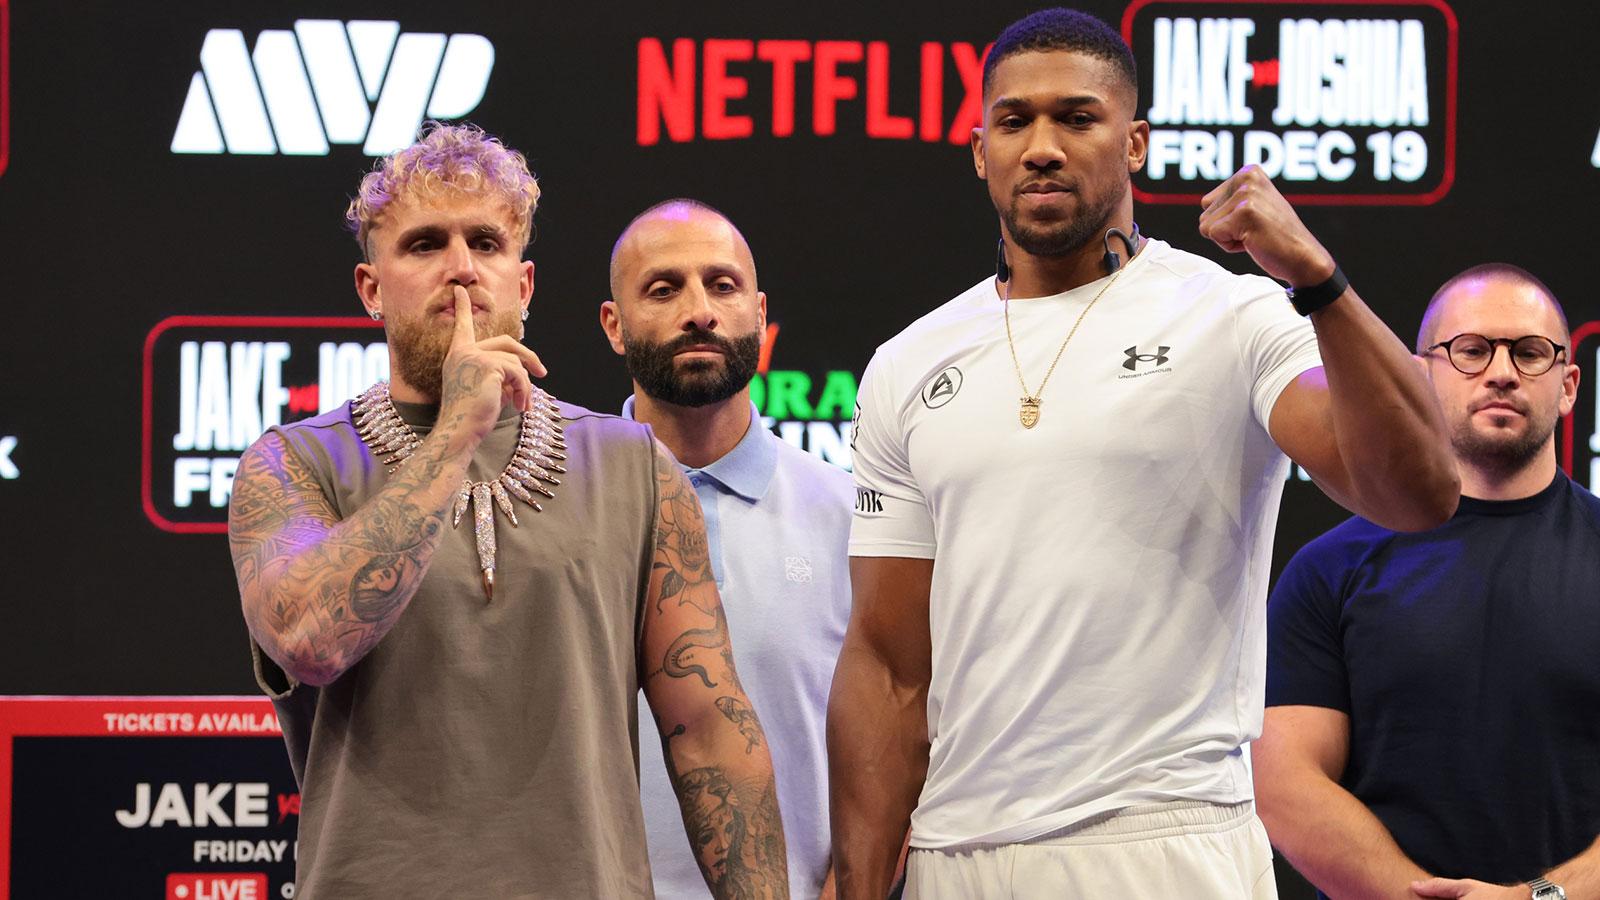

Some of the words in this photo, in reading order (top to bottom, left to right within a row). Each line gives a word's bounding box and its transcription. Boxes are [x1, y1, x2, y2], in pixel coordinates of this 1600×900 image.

[636, 37, 992, 146] NETFLIX
[1148, 17, 1255, 125] JAKE
[1272, 18, 1429, 127] JOSHUA
[1148, 130, 1234, 181] FRI
[1244, 130, 1356, 182] DEC
[1366, 131, 1428, 182] 19
[173, 341, 291, 450] JAKE
[104, 713, 194, 732] TICKETS
[115, 782, 269, 828] JAKE
[193, 840, 288, 863] FRIDAY
[195, 880, 258, 900] LIVE
